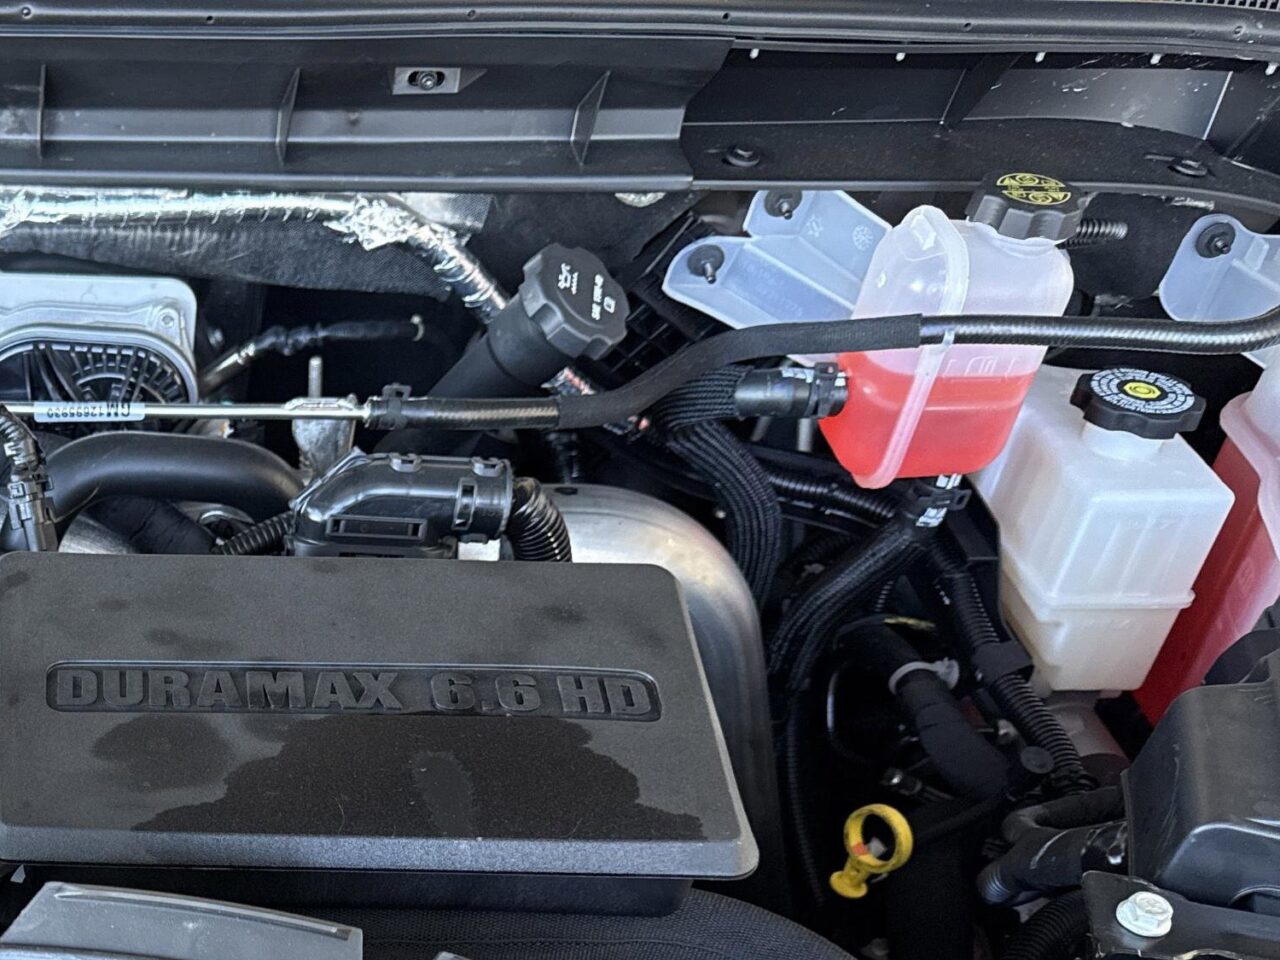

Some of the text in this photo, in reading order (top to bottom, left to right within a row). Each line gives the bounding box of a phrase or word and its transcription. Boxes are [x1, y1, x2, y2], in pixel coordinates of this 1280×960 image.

[56, 668, 653, 717] DURAMAX 6.6 HD
